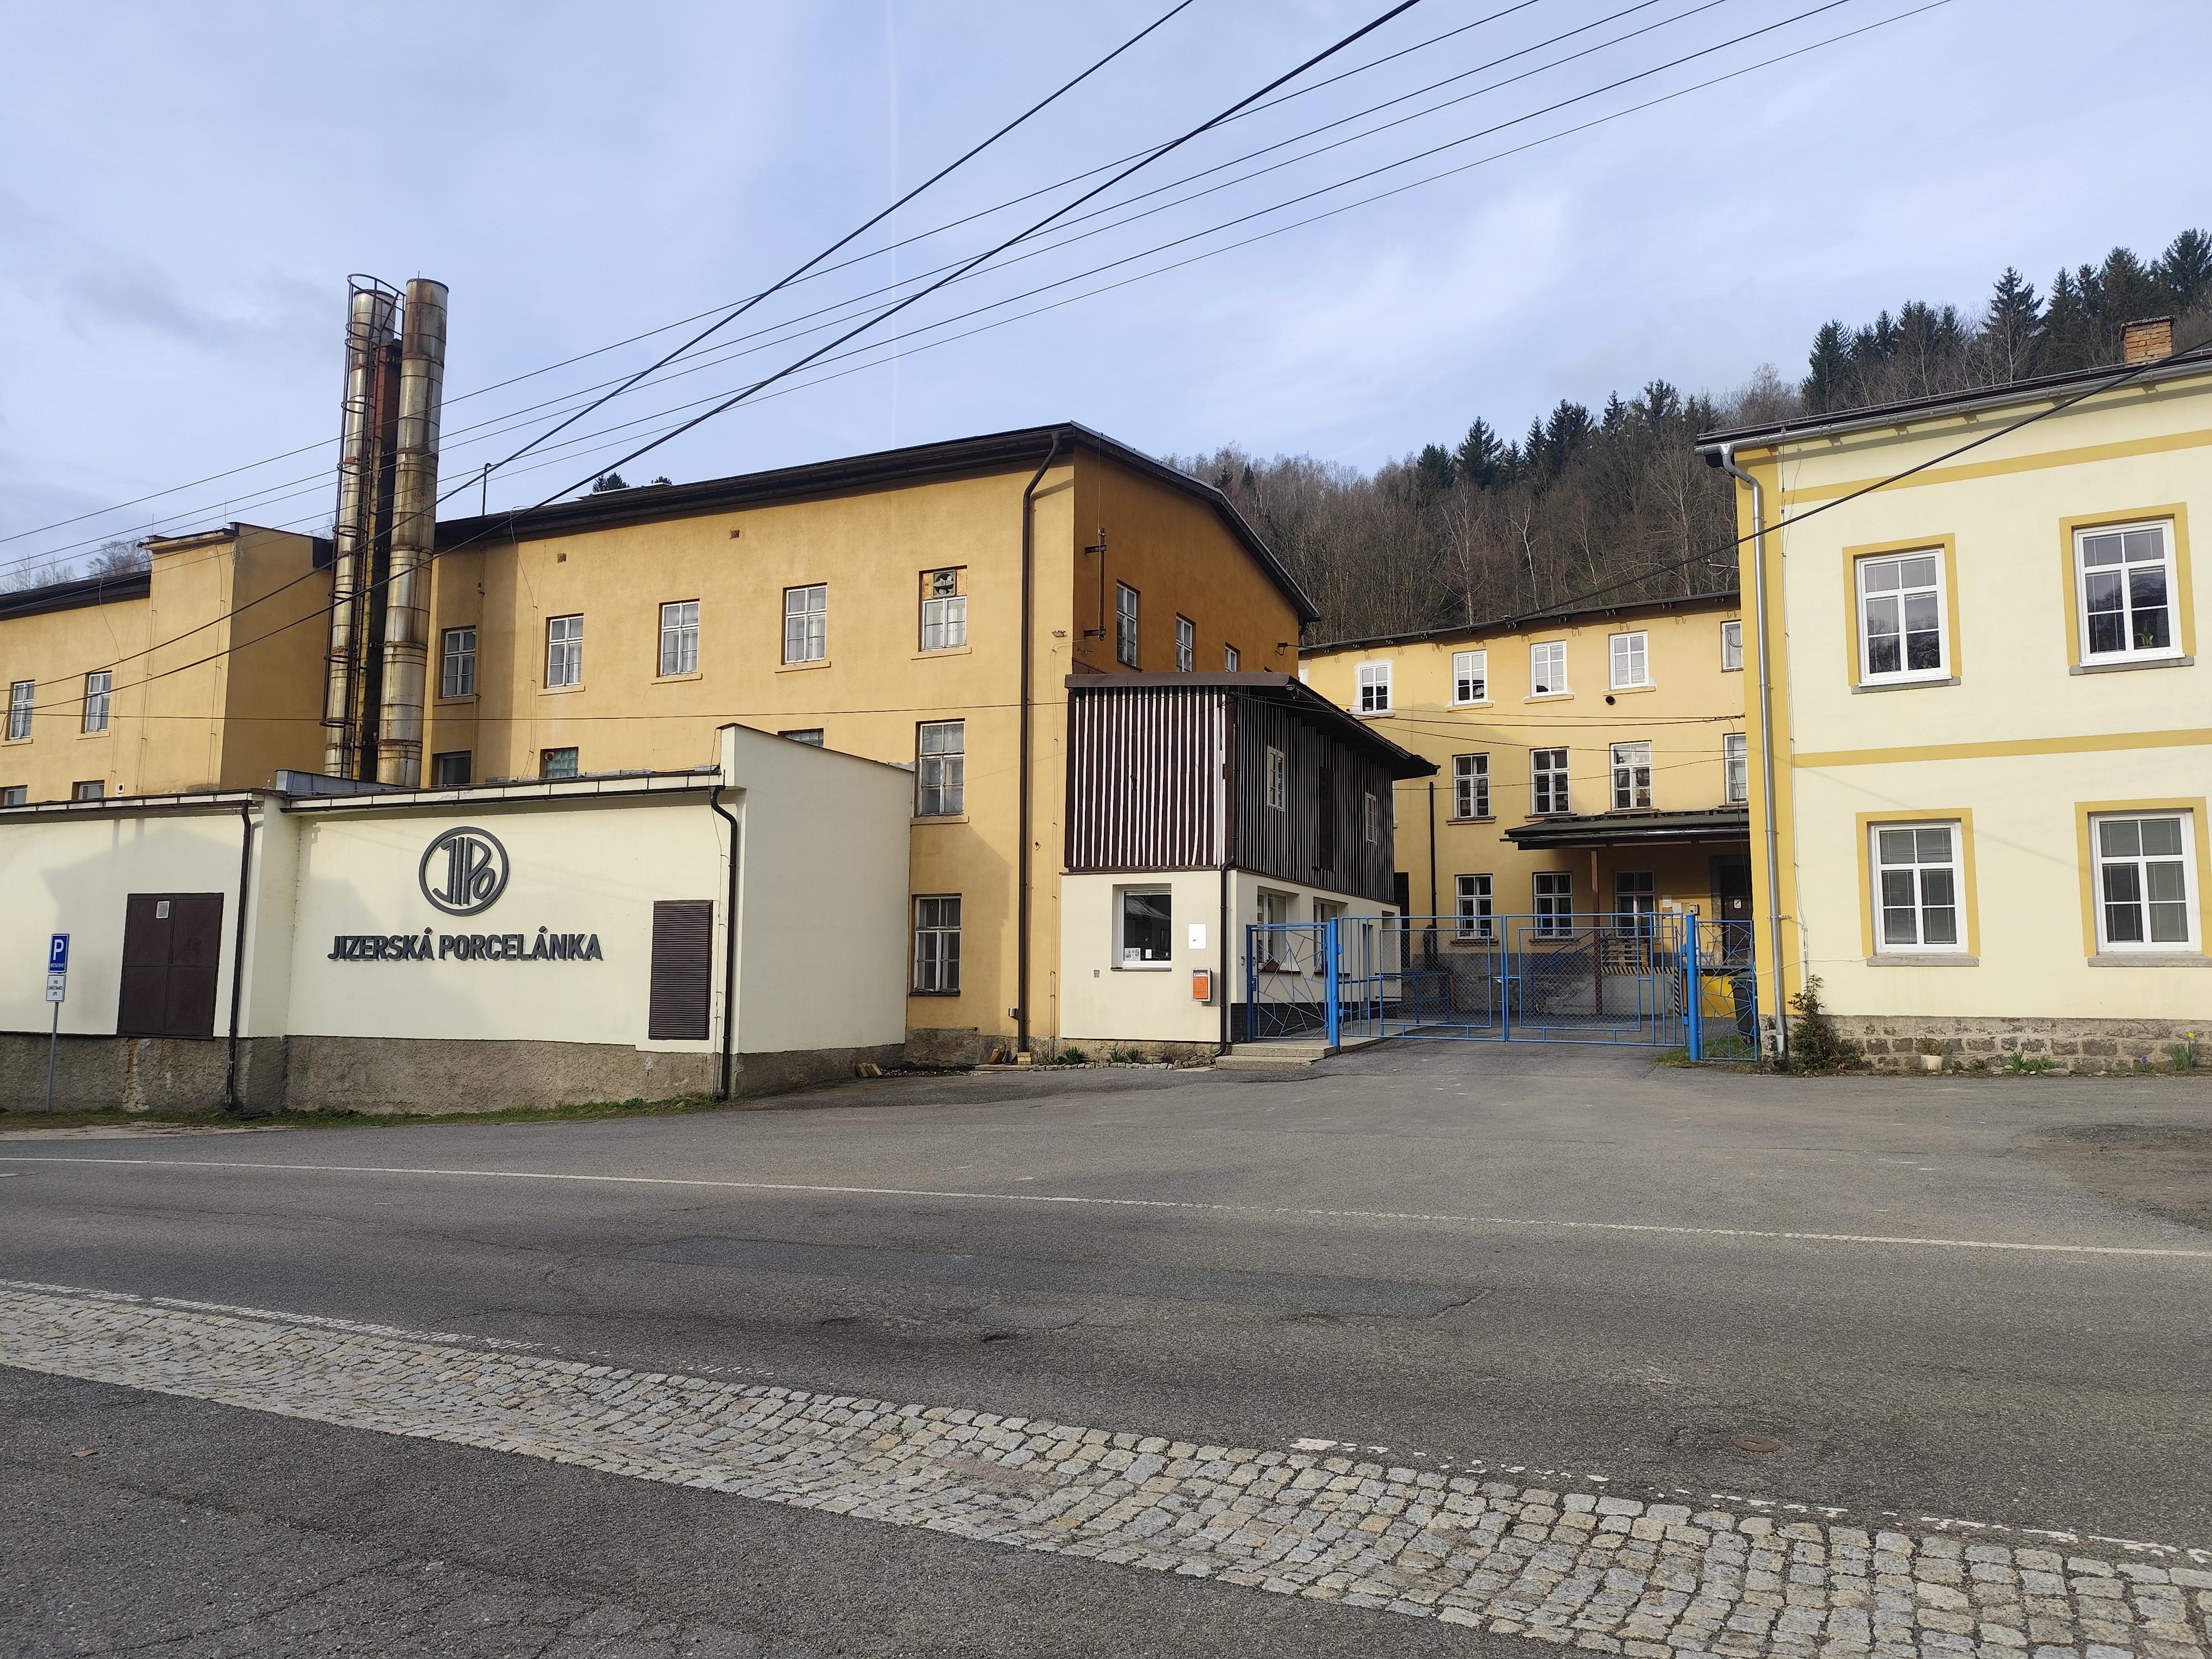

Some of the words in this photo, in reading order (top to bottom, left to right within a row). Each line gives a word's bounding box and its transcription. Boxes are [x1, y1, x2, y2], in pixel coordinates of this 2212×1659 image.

[53, 939, 64, 960] P
[327, 927, 435, 961] JIZERSKÁ
[439, 926, 603, 961] PORCELÁNKA
